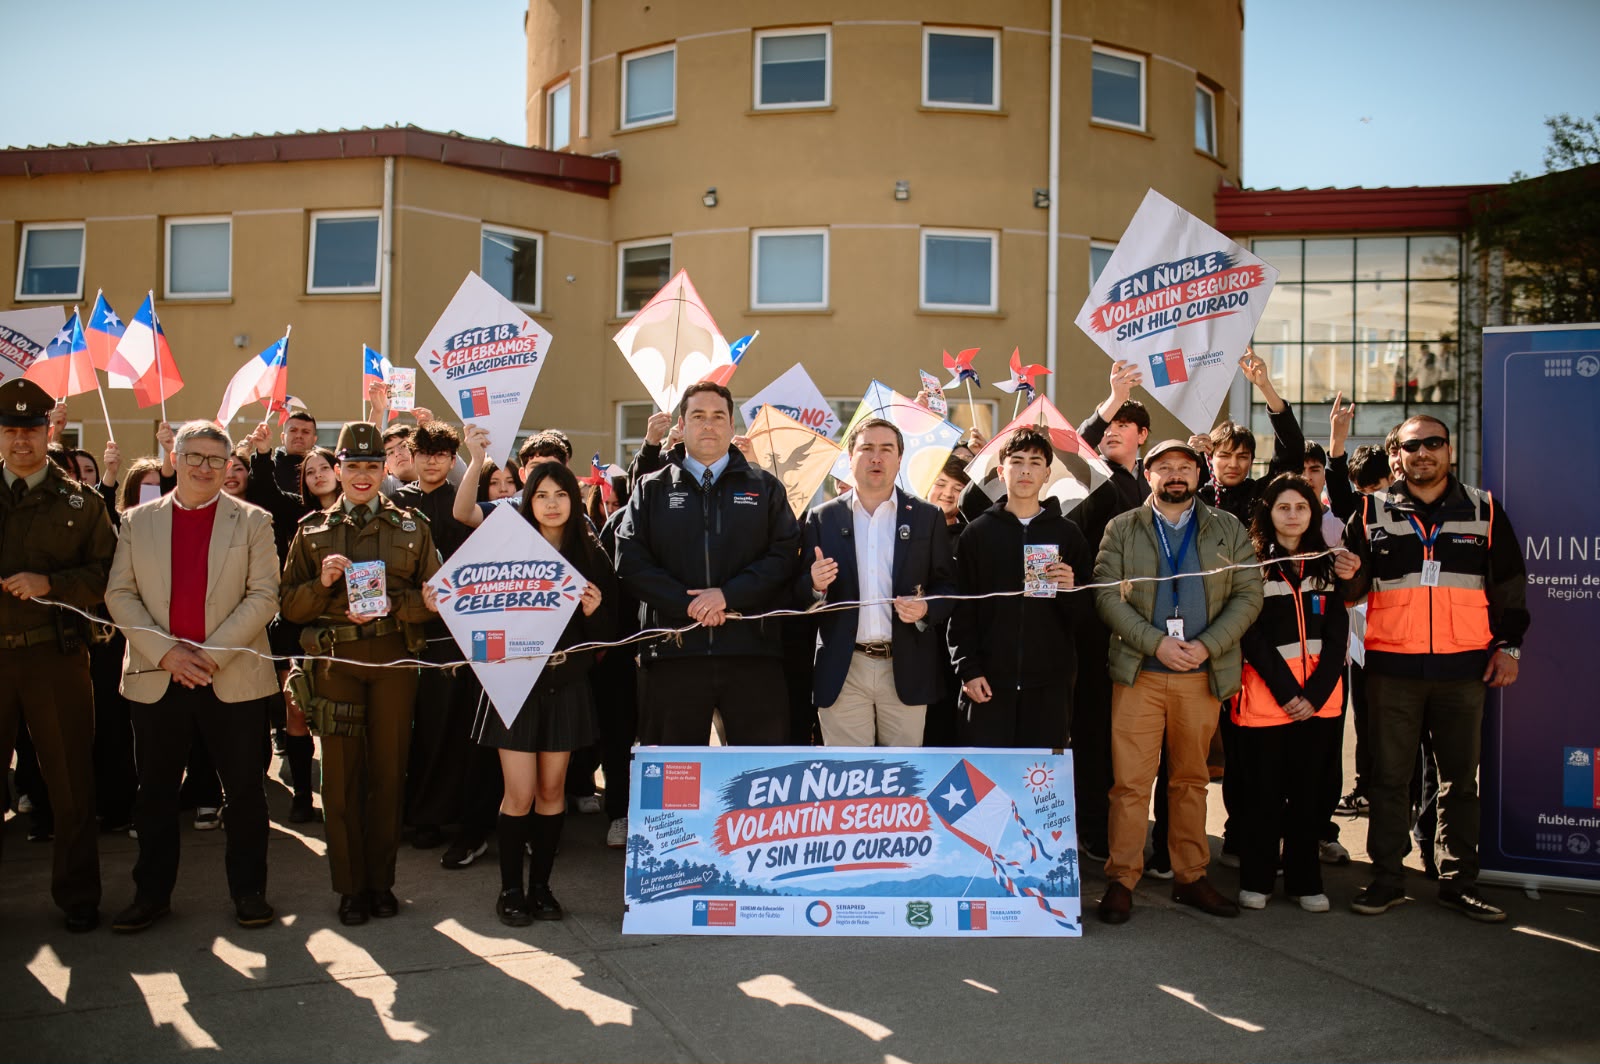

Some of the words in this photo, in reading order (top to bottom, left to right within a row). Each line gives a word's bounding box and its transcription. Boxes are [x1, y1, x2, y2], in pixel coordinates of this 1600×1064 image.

[1119, 274, 1147, 302] EN
[1153, 253, 1223, 289] ÑUBLE,
[1101, 287, 1182, 328] VOLANTÍN
[1186, 270, 1255, 300] SEGURO:
[1116, 318, 1144, 342] SIN
[1148, 307, 1182, 330] HILO
[1186, 290, 1249, 318] CURADO
[453, 328, 490, 350] ESTE
[494, 324, 514, 341] 18,
[446, 338, 532, 367] CELEBRAMOS
[1187, 350, 1224, 363] TRABAJANDO
[446, 365, 466, 380] SIN
[467, 351, 538, 371] ACCIDENTES
[1202, 357, 1222, 366] USTED
[799, 408, 825, 428] NO
[458, 563, 557, 586] CUIDARNOS
[1527, 573, 1577, 585] Seremi
[473, 579, 525, 594] TAMBIÉN
[526, 580, 541, 590] ES
[1547, 587, 1593, 601] Región
[454, 591, 561, 612] CELEBRAR
[747, 774, 792, 808] EN
[799, 761, 906, 802] ÑUBLE,
[1033, 790, 1057, 806] Vuela
[1035, 803, 1050, 815] más
[1051, 799, 1065, 810] alto
[1047, 811, 1057, 820] sin
[644, 811, 675, 825] Nuestras
[648, 817, 684, 832] tradiciones
[726, 801, 835, 846] VOLANTÍN
[839, 802, 924, 832] SEGURO
[1042, 815, 1071, 830] riesgos
[656, 826, 684, 840] también
[660, 841, 669, 849] se
[670, 832, 696, 846] cuidan
[746, 848, 762, 872] Y
[765, 843, 798, 868] SIN
[803, 839, 847, 865] HILO
[852, 835, 933, 860] CURADO
[640, 876, 649, 886] La
[650, 870, 685, 886] prevención
[640, 883, 665, 895] también
[673, 876, 703, 888] educación
